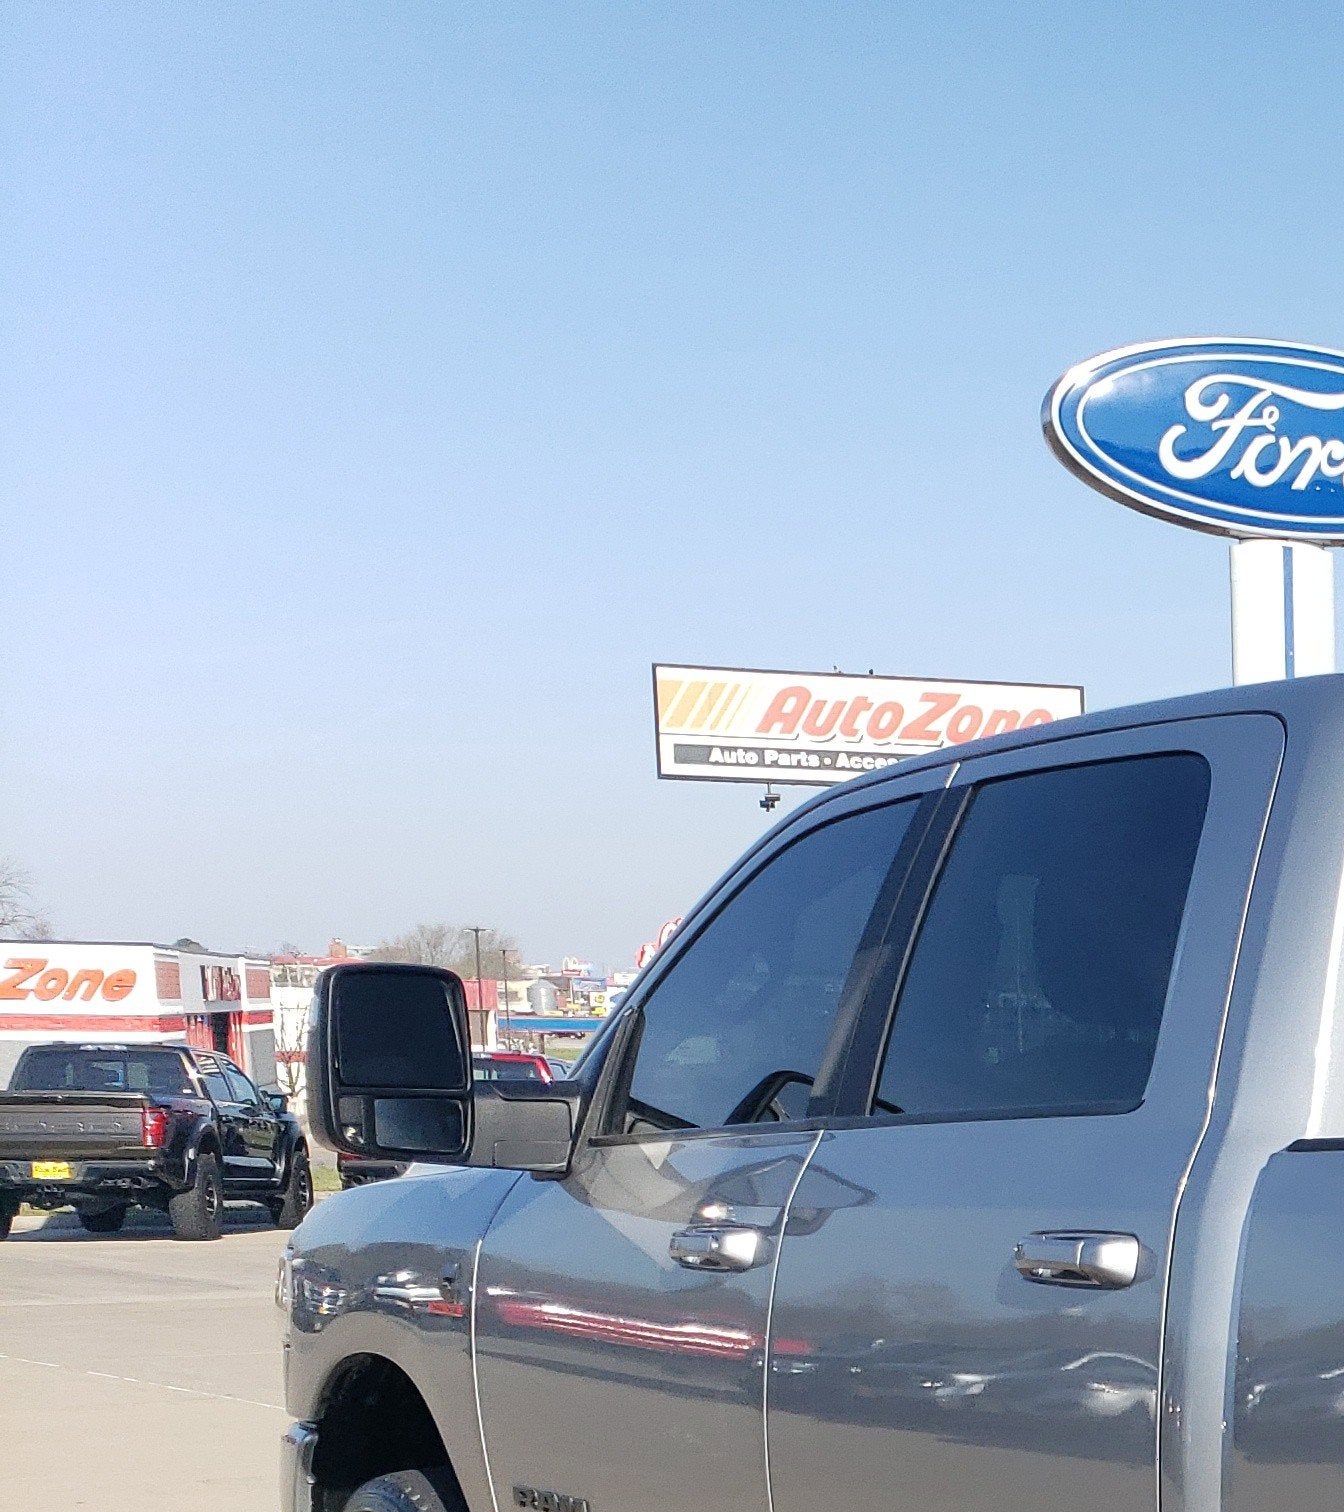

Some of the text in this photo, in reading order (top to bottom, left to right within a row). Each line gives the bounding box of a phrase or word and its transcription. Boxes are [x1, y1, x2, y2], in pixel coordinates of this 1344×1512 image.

[709, 748, 759, 766] Auto
[764, 750, 820, 768] Parts
[0, 957, 138, 1002] Zone
